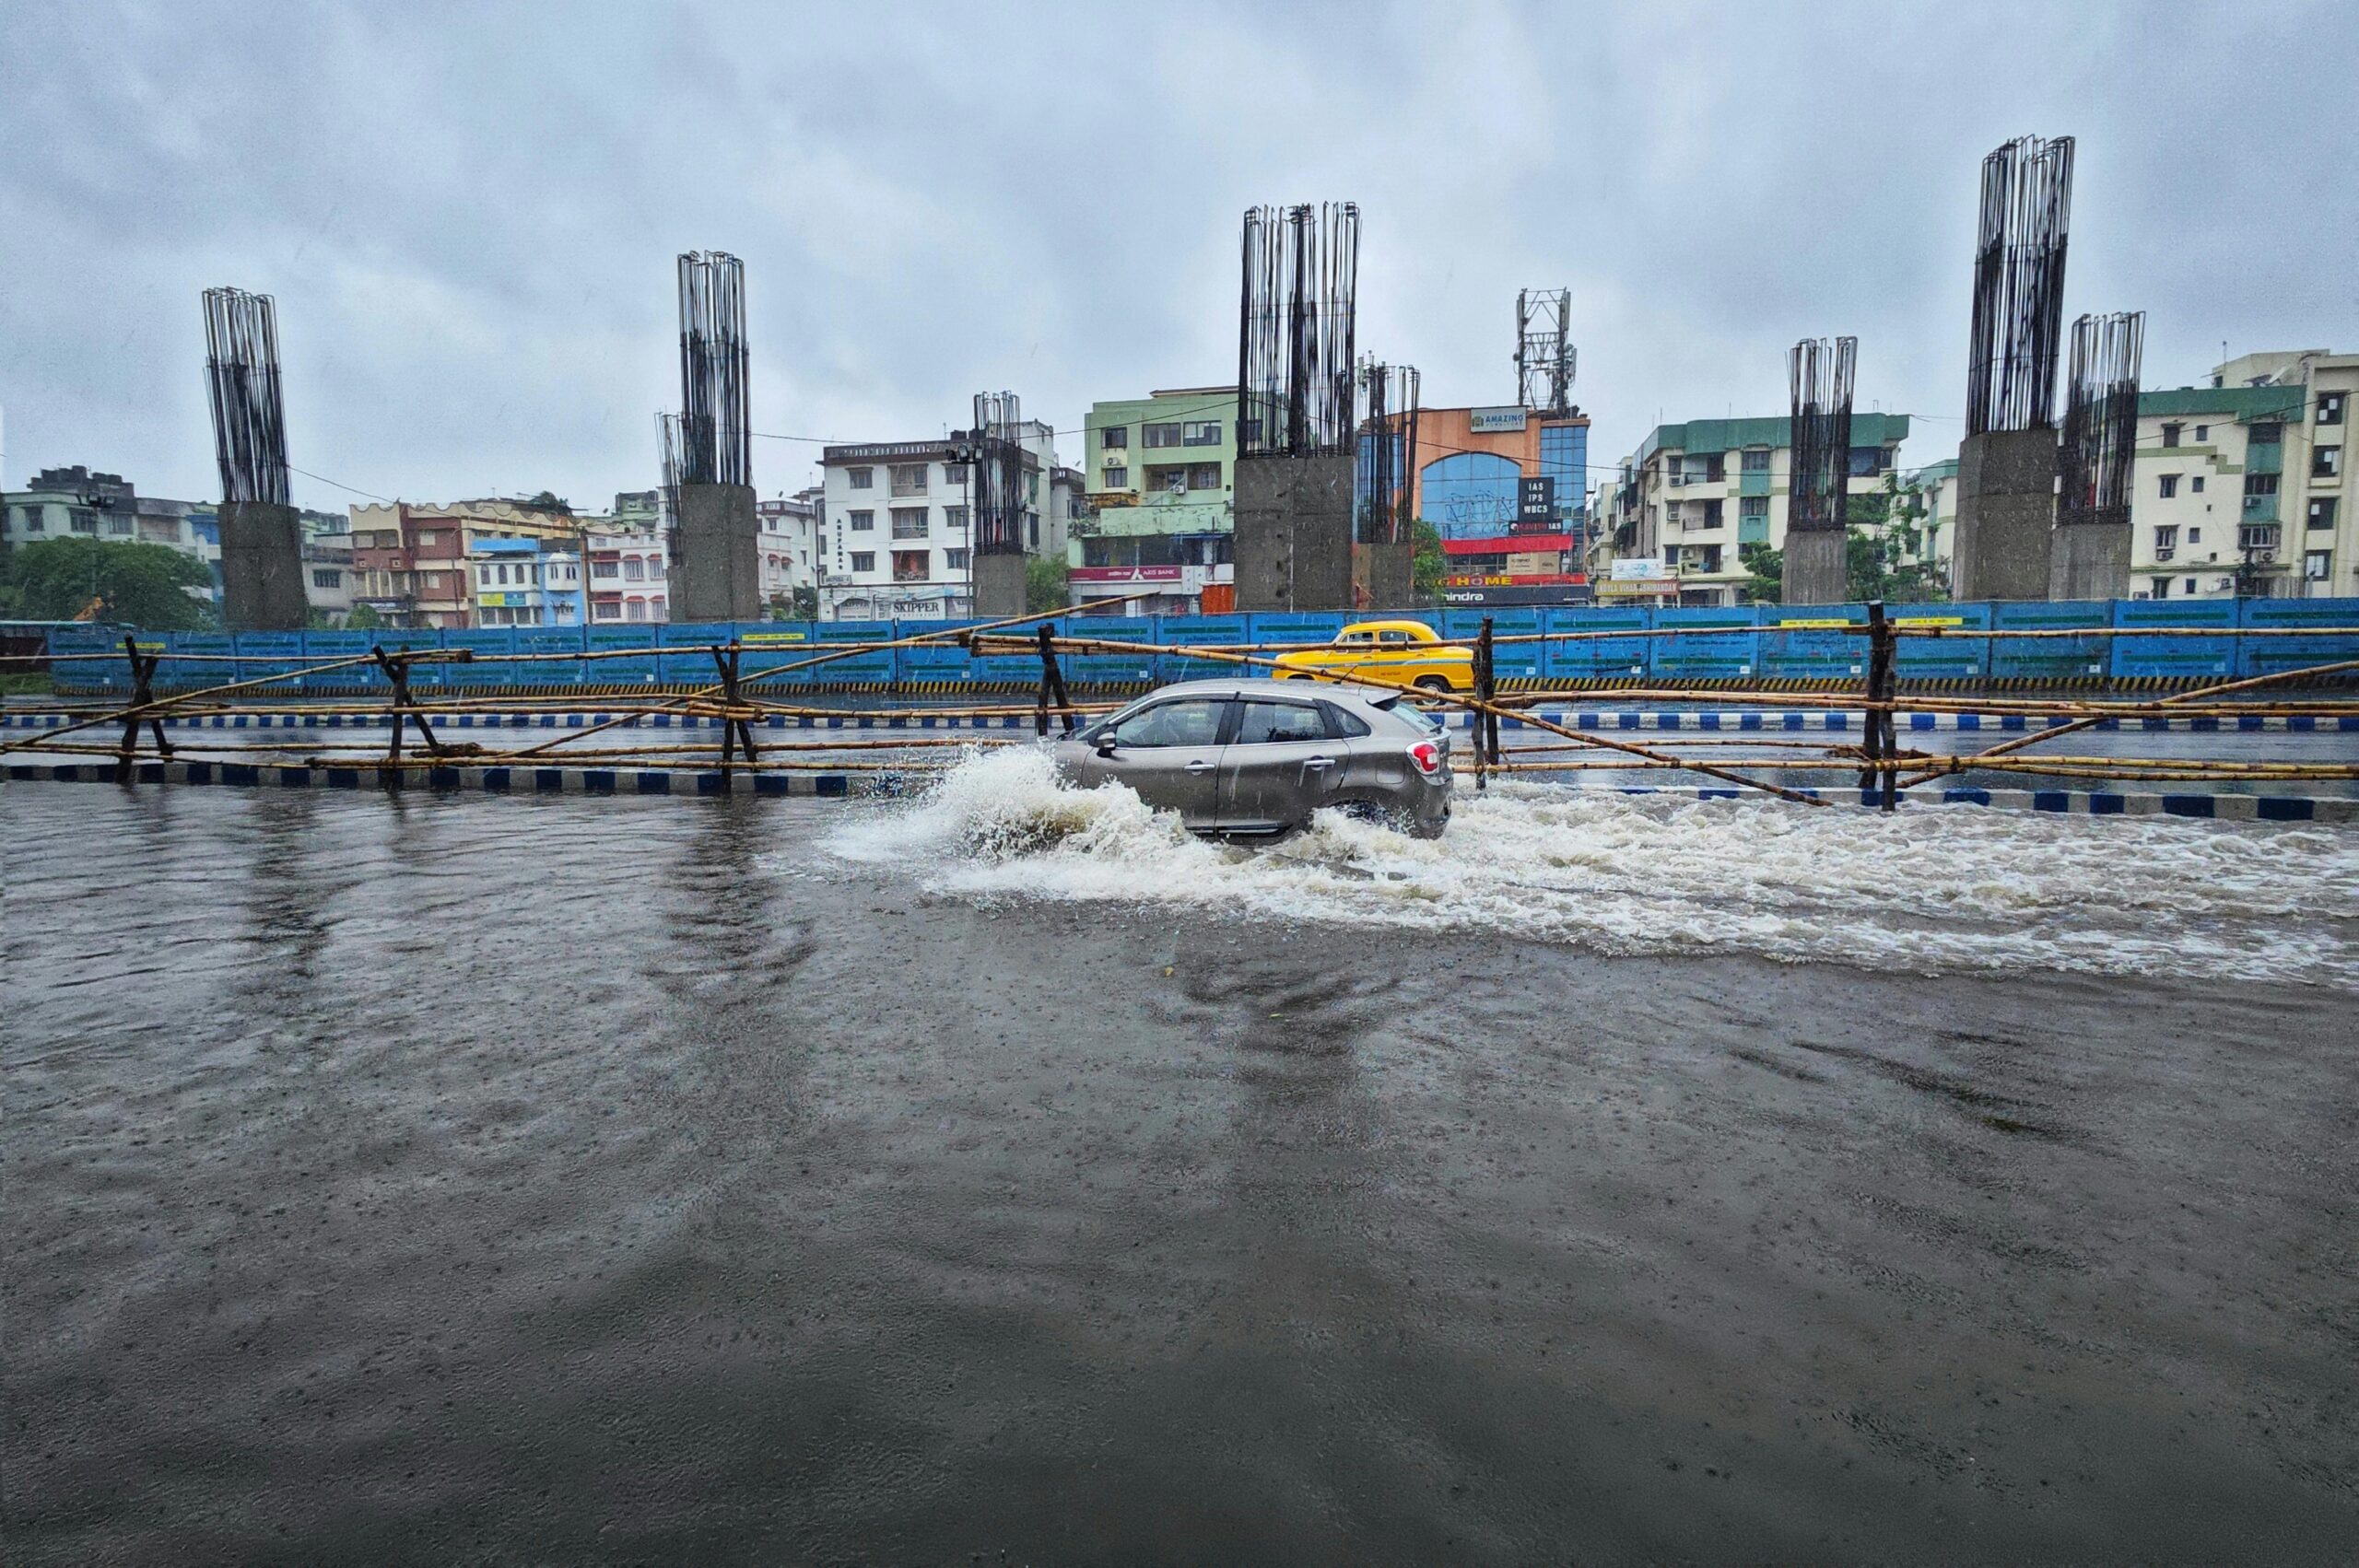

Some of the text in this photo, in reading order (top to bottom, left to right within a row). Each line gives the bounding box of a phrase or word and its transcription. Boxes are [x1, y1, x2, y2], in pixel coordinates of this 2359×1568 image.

[1485, 415, 1523, 423] AMAZING
[1529, 483, 1543, 491] IAS
[1528, 494, 1543, 502] IPS
[1524, 505, 1548, 514] WBCS
[1456, 576, 1512, 586] HOME
[1434, 591, 1484, 602] hindra
[893, 602, 939, 613] SKIPPER
